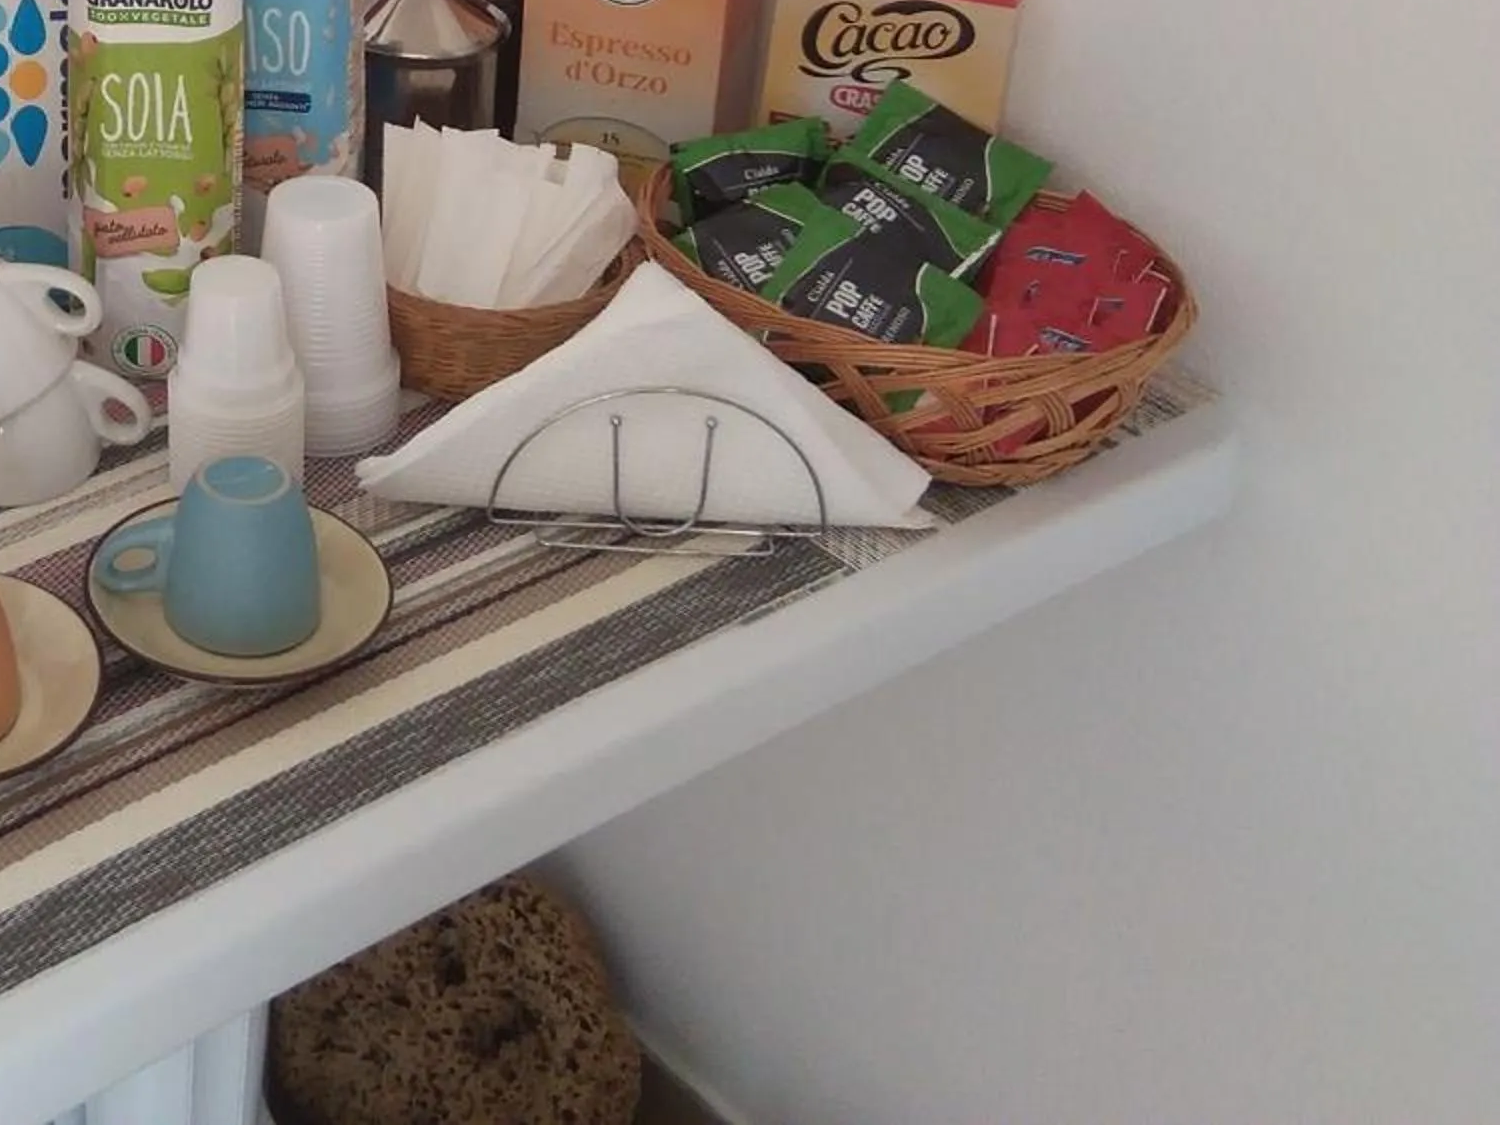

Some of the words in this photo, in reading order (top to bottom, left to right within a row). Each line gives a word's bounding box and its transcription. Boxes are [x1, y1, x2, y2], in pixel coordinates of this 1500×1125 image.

[247, 7, 311, 75] ISO
[552, 21, 692, 66] Espresso
[800, 0, 976, 75] Cacao
[565, 60, 668, 94] d'Orzo
[100, 72, 193, 143] SOIA
[900, 154, 930, 183] OP
[853, 188, 897, 223] POP
[734, 251, 774, 285] POP
[825, 280, 863, 320] POP
